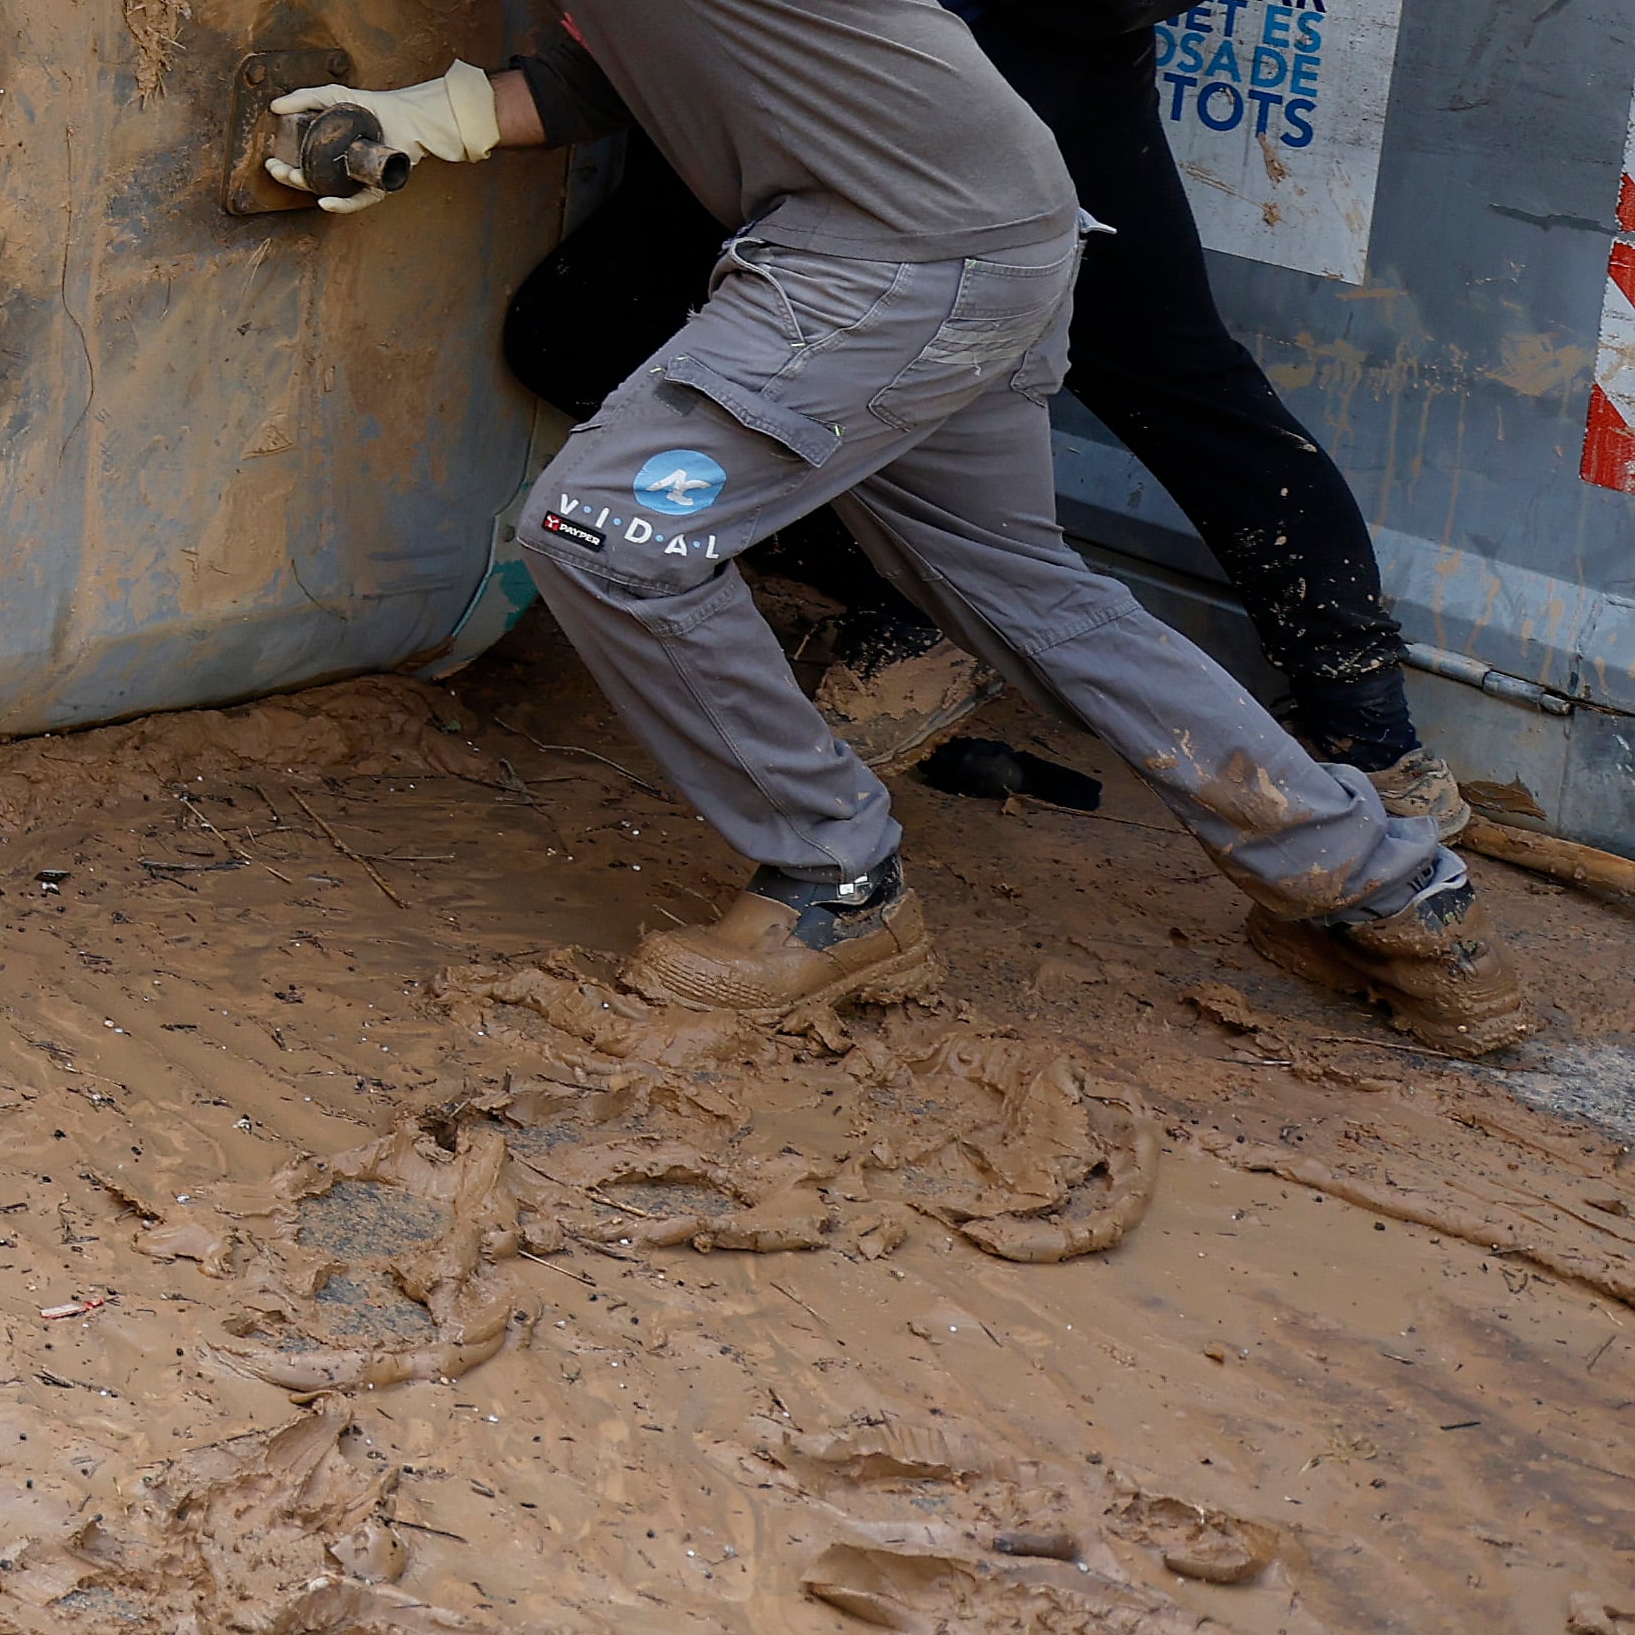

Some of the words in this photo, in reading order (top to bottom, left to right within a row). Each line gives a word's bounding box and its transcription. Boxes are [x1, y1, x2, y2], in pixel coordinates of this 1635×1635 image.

[1262, 4, 1326, 54] ES
[1250, 46, 1322, 98] DE
[1164, 72, 1318, 148] TOTS
[559, 522, 601, 547] PAYPER
